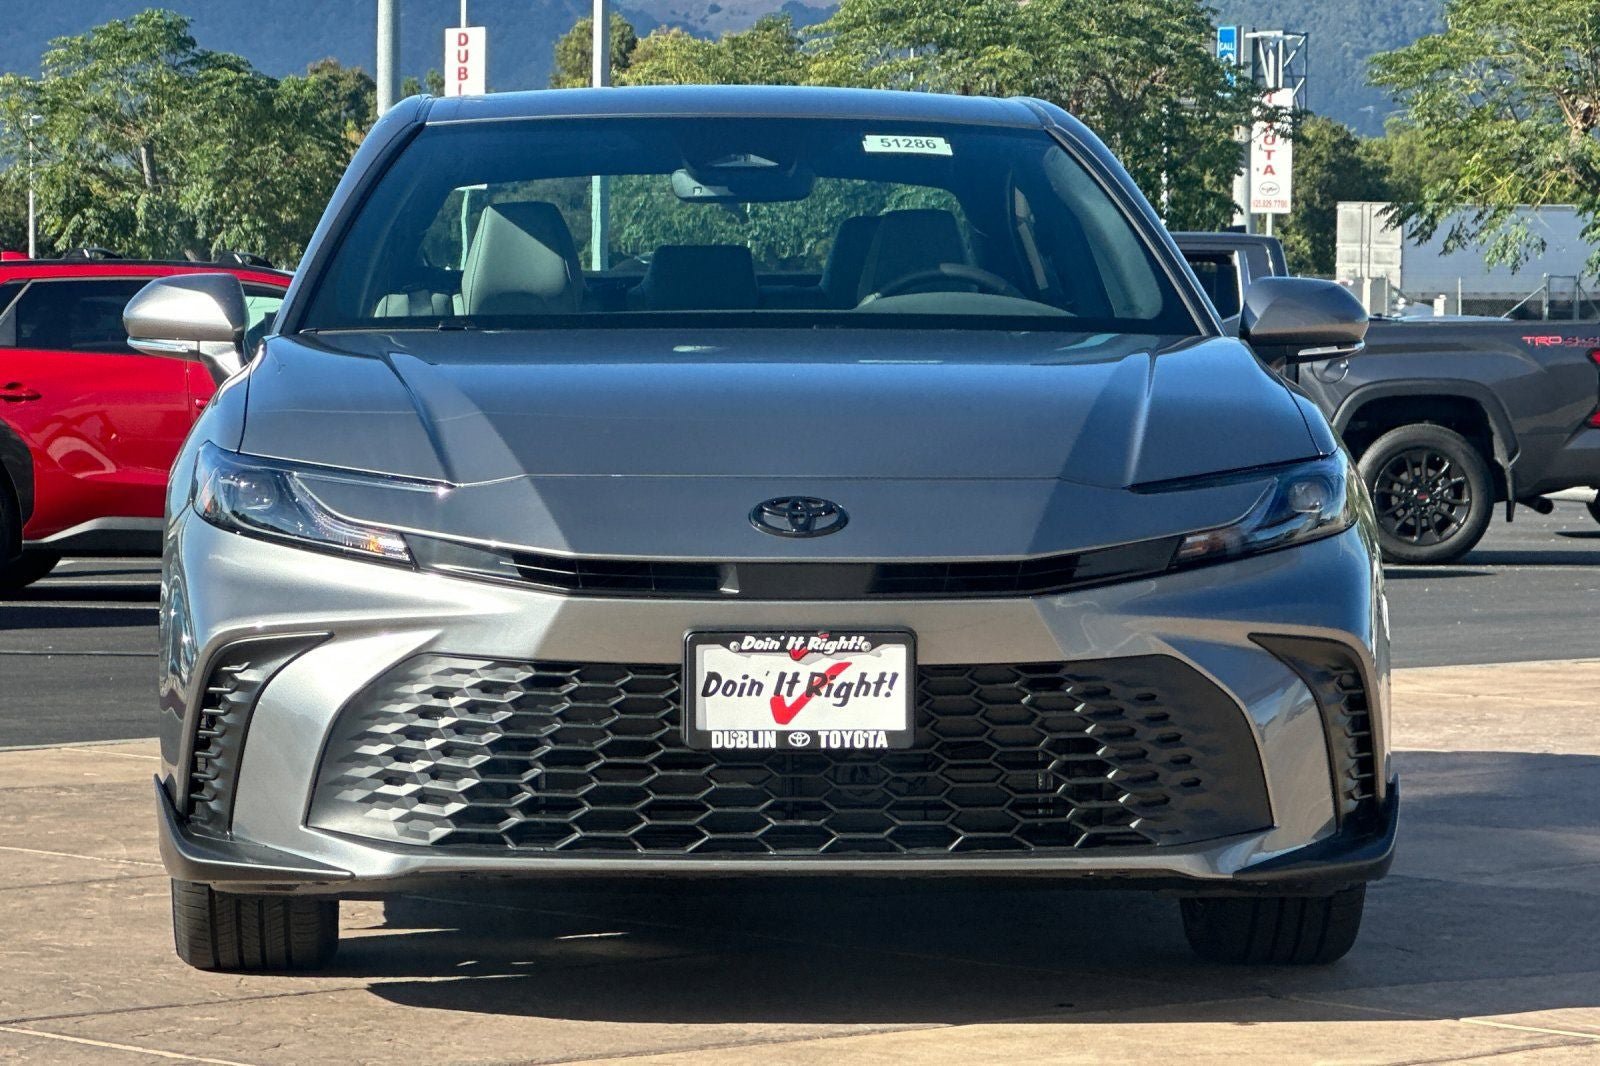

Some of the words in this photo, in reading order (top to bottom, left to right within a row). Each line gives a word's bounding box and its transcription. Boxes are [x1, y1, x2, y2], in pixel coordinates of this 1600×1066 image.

[1219, 42, 1235, 51] CALL
[880, 138, 937, 149] 51286
[1522, 335, 1563, 346] TRD
[741, 635, 785, 650] Doin'
[786, 636, 805, 650] It
[807, 635, 865, 655] Right!
[701, 671, 770, 698] Doin'
[774, 671, 803, 698] It
[805, 671, 899, 708] Right!
[711, 730, 777, 749] DUBLIN
[818, 730, 889, 749] TOYOTA
